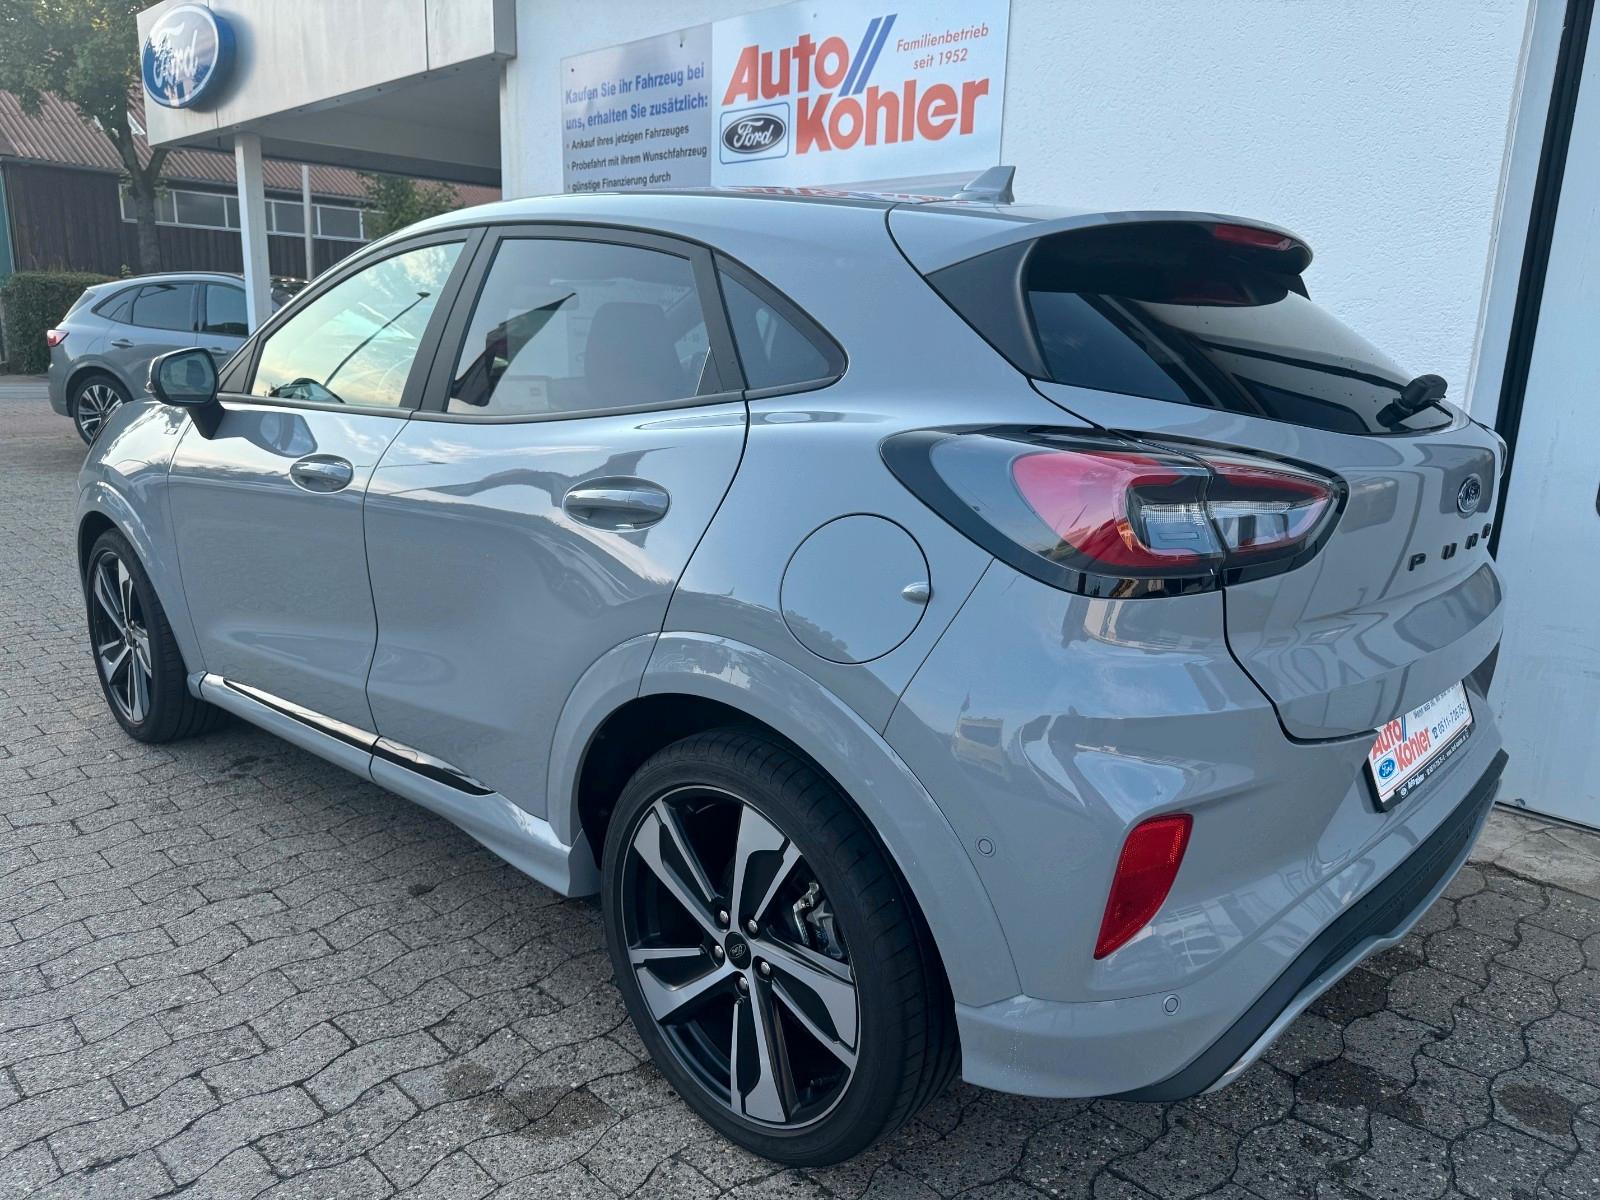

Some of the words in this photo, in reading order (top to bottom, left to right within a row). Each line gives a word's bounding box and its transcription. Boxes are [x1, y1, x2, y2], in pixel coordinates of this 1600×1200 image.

[896, 23, 989, 52] Familienbetrieb
[722, 33, 850, 106] Auto
[913, 56, 934, 70] seit
[938, 48, 968, 65] 1952
[565, 87, 598, 105] Kaufen
[601, 81, 616, 98] Sie
[619, 78, 632, 94] ihr
[635, 70, 684, 91] Fahrzeug
[687, 62, 705, 79] bei
[566, 116, 586, 131] uns,
[587, 109, 628, 127] erhalten
[630, 103, 647, 119] Sie
[649, 92, 709, 116] zusätzlich:
[571, 136, 596, 150] Ankauf
[615, 131, 643, 147] jetzigen
[644, 124, 689, 140] Fahrzeuges
[732, 119, 774, 148] Ford
[571, 157, 607, 171] Probefahrt
[608, 156, 619, 168] mit
[642, 146, 708, 162] Wunschfahrzeug
[602, 174, 648, 189] Finanzierung
[649, 171, 671, 184] durch
[1372, 719, 1403, 759] Auto
